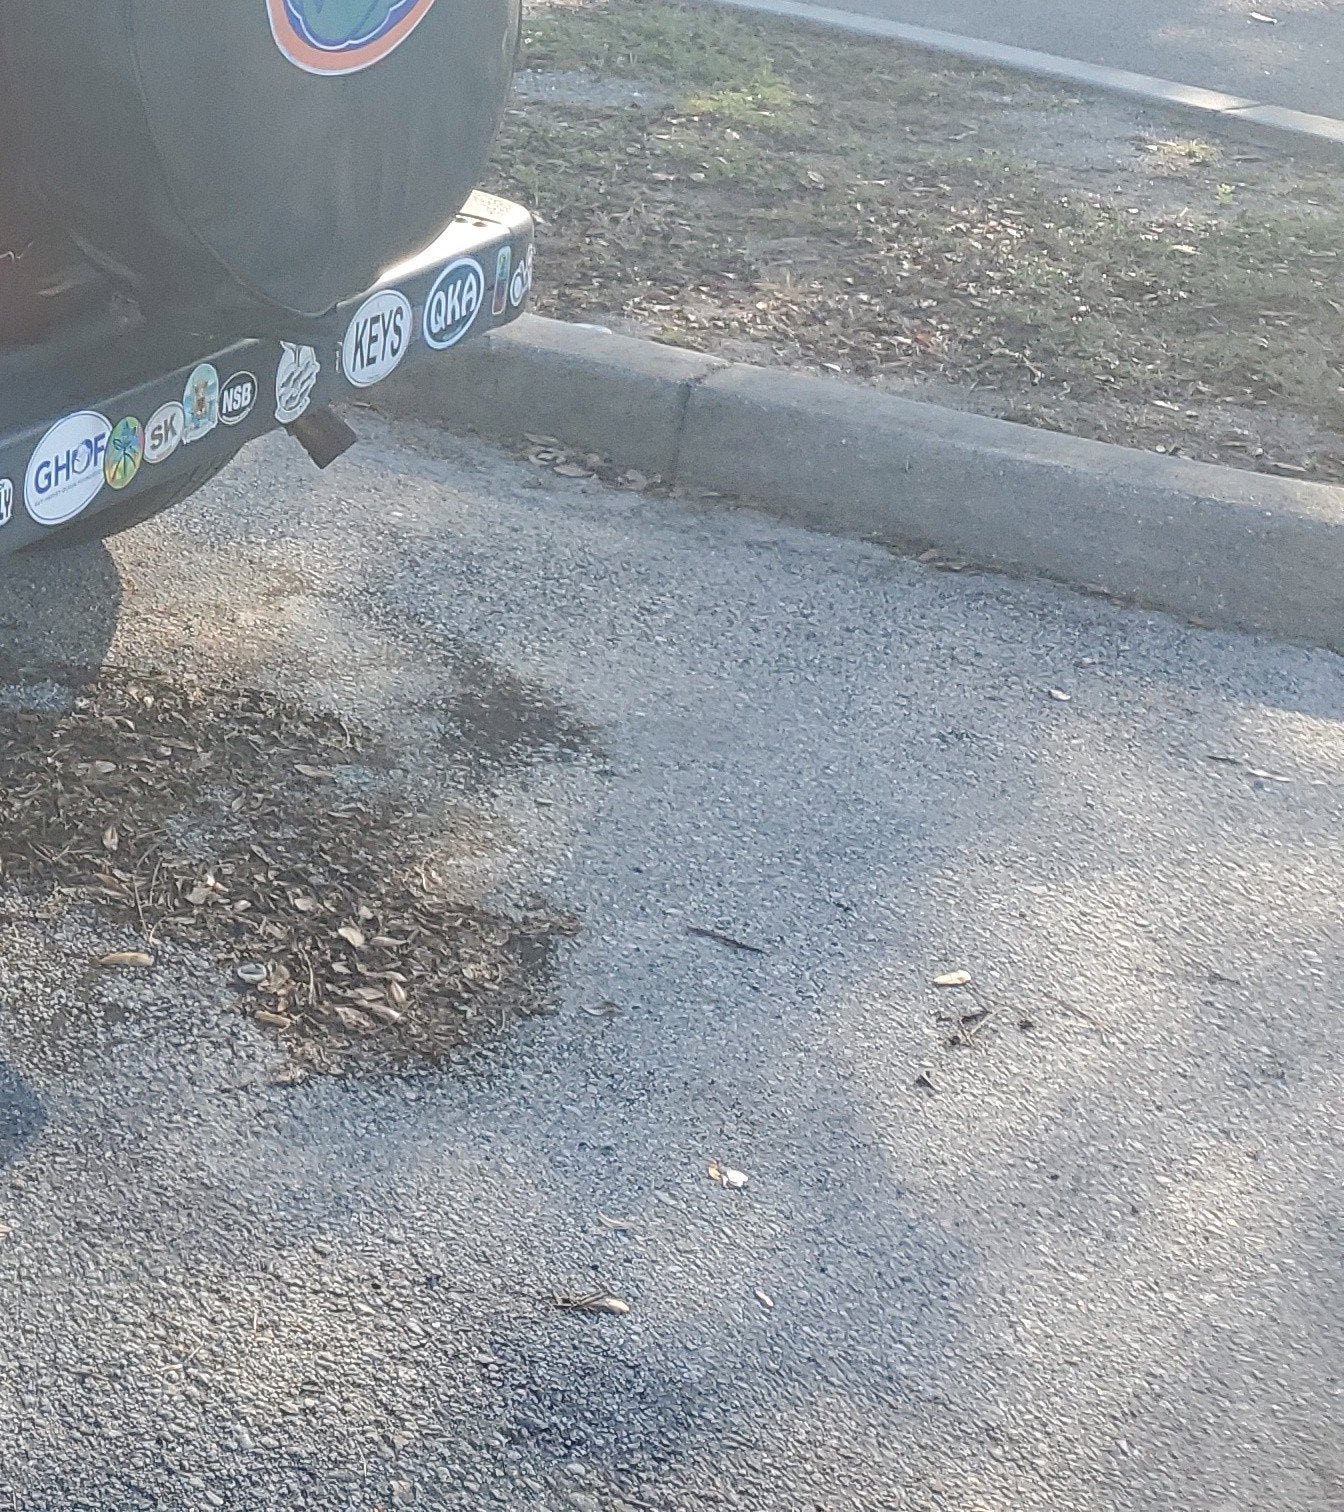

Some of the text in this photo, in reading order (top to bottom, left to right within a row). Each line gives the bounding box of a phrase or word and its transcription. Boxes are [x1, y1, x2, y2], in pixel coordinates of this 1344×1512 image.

[430, 273, 478, 334] QKA
[352, 306, 404, 373] KEYS
[222, 382, 252, 414] NSB
[150, 413, 178, 451] SK
[34, 432, 107, 495] GHOF
